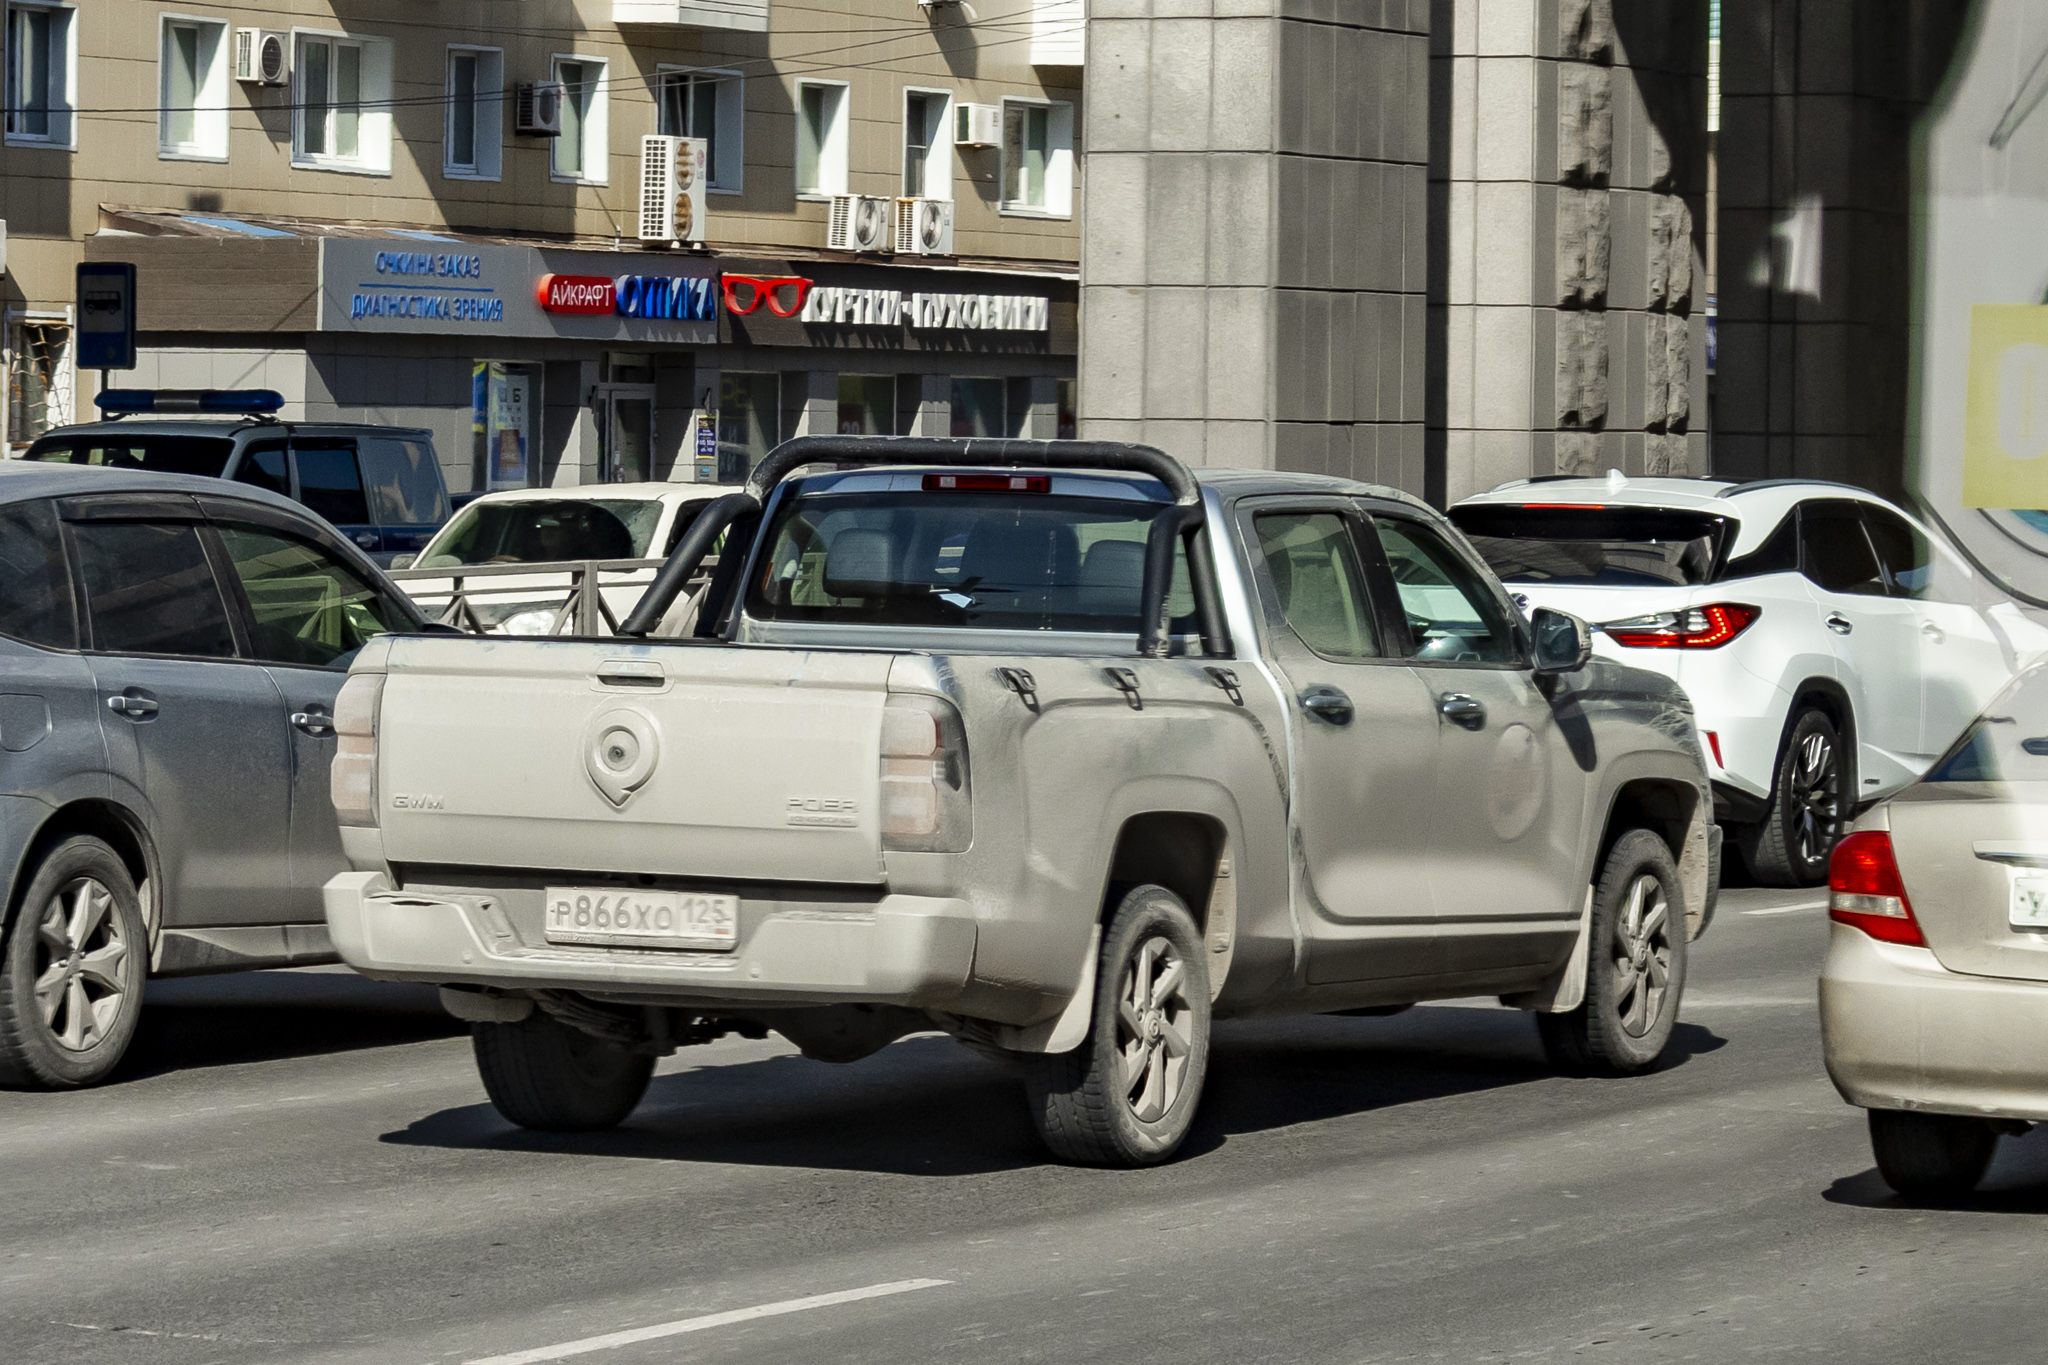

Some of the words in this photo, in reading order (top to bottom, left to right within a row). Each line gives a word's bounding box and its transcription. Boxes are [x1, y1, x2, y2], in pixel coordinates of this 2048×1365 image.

[375, 252, 413, 274] ОЧКИ
[414, 253, 435, 275] НА
[437, 254, 481, 279] ЗАКАЗ
[551, 279, 613, 307] АЙКРАФТ
[616, 274, 716, 321] ОПТИКА
[351, 294, 450, 321] ДИАГНОСТИКА
[452, 297, 503, 321] ЗРЕНИЯ
[393, 794, 444, 810] GWM
